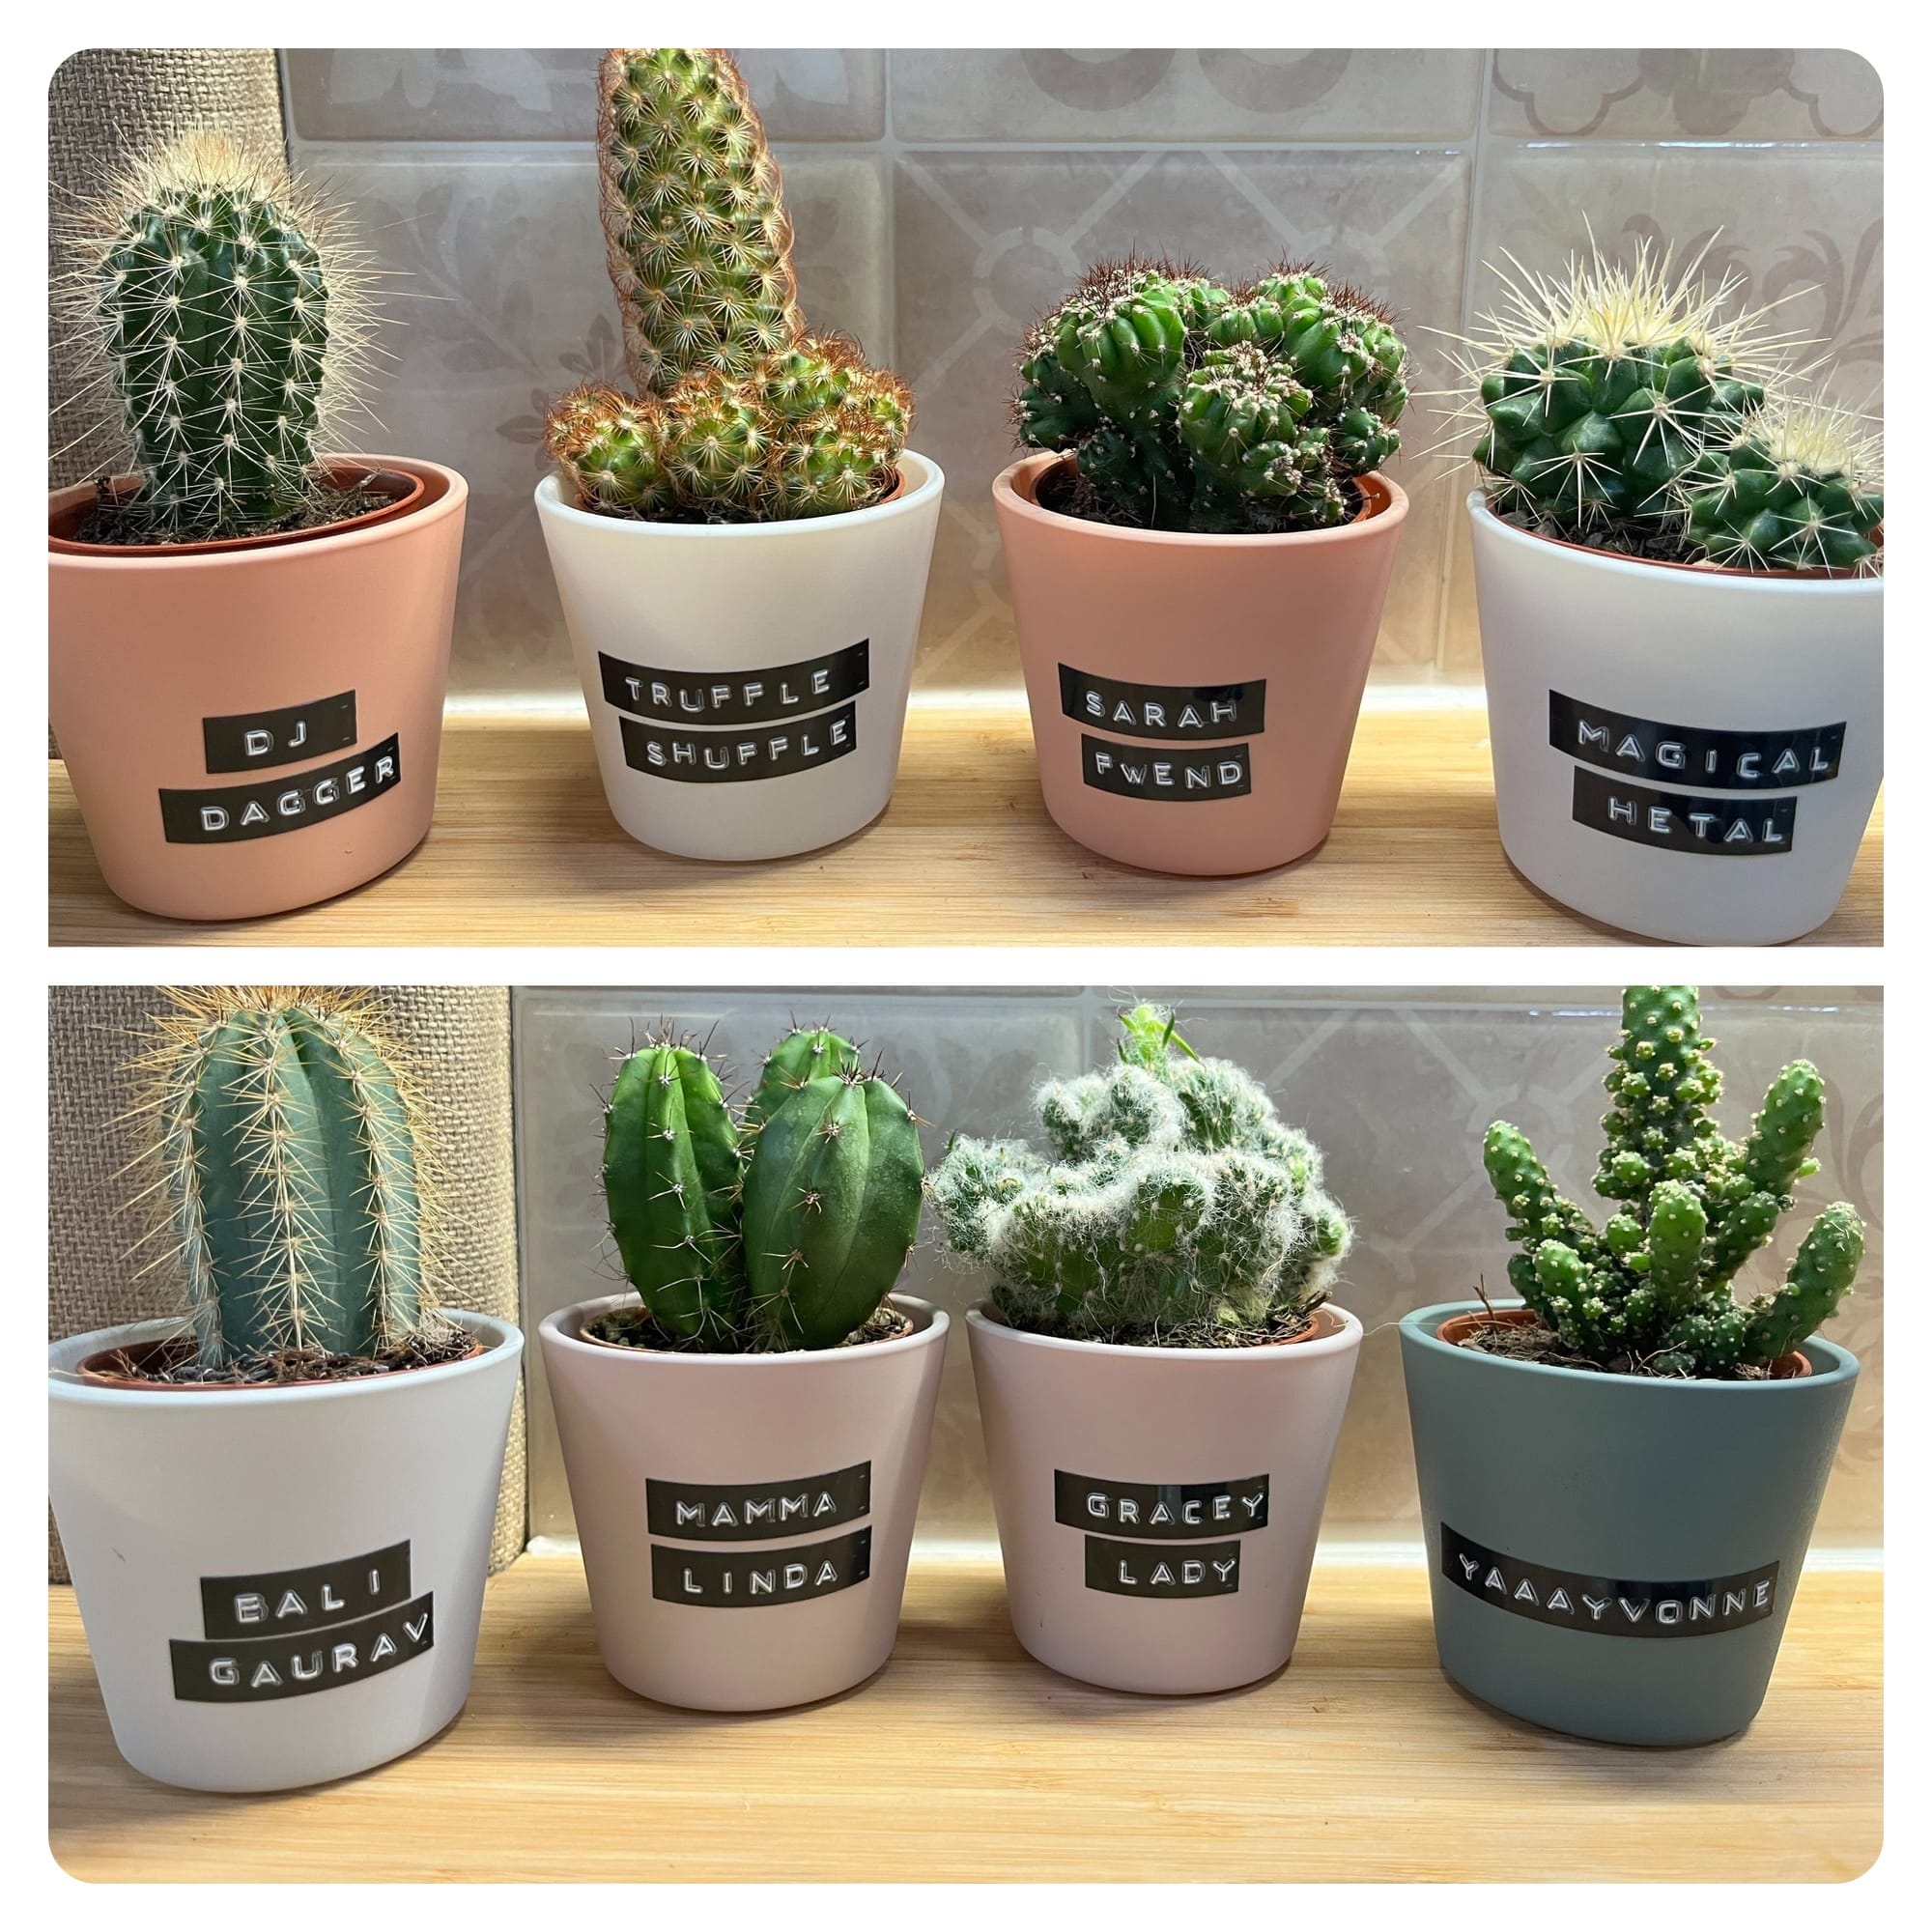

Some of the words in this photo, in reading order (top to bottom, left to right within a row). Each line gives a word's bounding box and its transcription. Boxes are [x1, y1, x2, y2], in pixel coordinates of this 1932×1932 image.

[625, 668, 830, 713] TRUFFLE
[1086, 691, 1236, 729] SARAH
[244, 721, 308, 756] DJ
[646, 719, 848, 769] SHUFFLE
[1577, 719, 1831, 780] MAGICAL
[1095, 752, 1244, 789] FWEND
[201, 755, 395, 832] DAGGER
[1608, 797, 1784, 844] HETAL
[676, 1491, 838, 1526] MAMMA
[1088, 1492, 1265, 1525] GRACEY
[683, 1559, 838, 1594] LINDA
[1119, 1558, 1236, 1585] LADY
[1457, 1554, 1774, 1625] YAAAYVONNE
[236, 1568, 381, 1623] BALI
[211, 1610, 429, 1686] GAURAV
